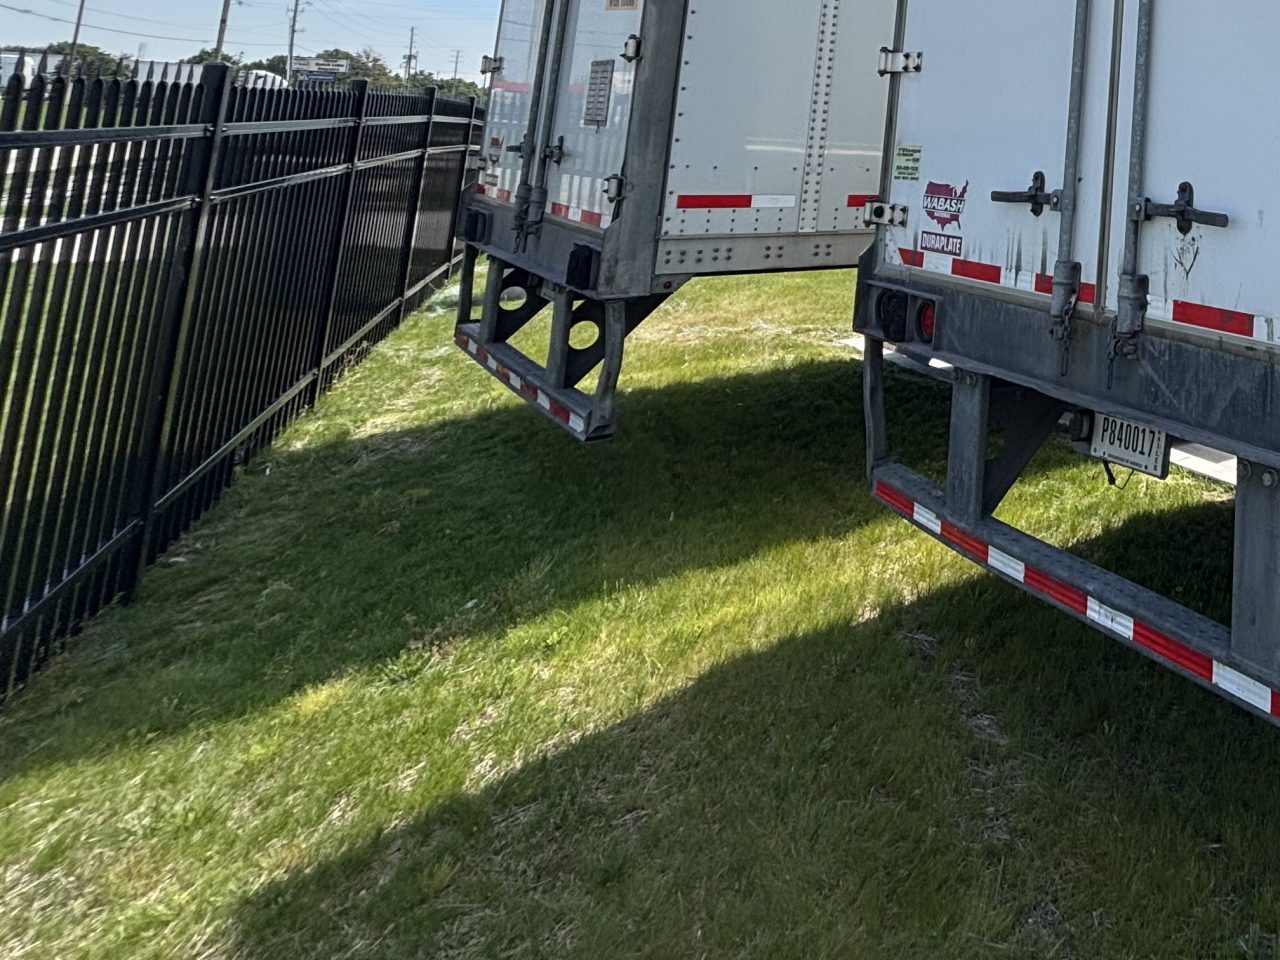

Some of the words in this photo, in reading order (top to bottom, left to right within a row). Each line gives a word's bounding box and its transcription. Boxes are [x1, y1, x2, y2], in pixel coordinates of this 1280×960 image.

[923, 196, 965, 213] WABASH
[922, 233, 962, 253] DURAPLATE
[1101, 417, 1156, 458] P840017
